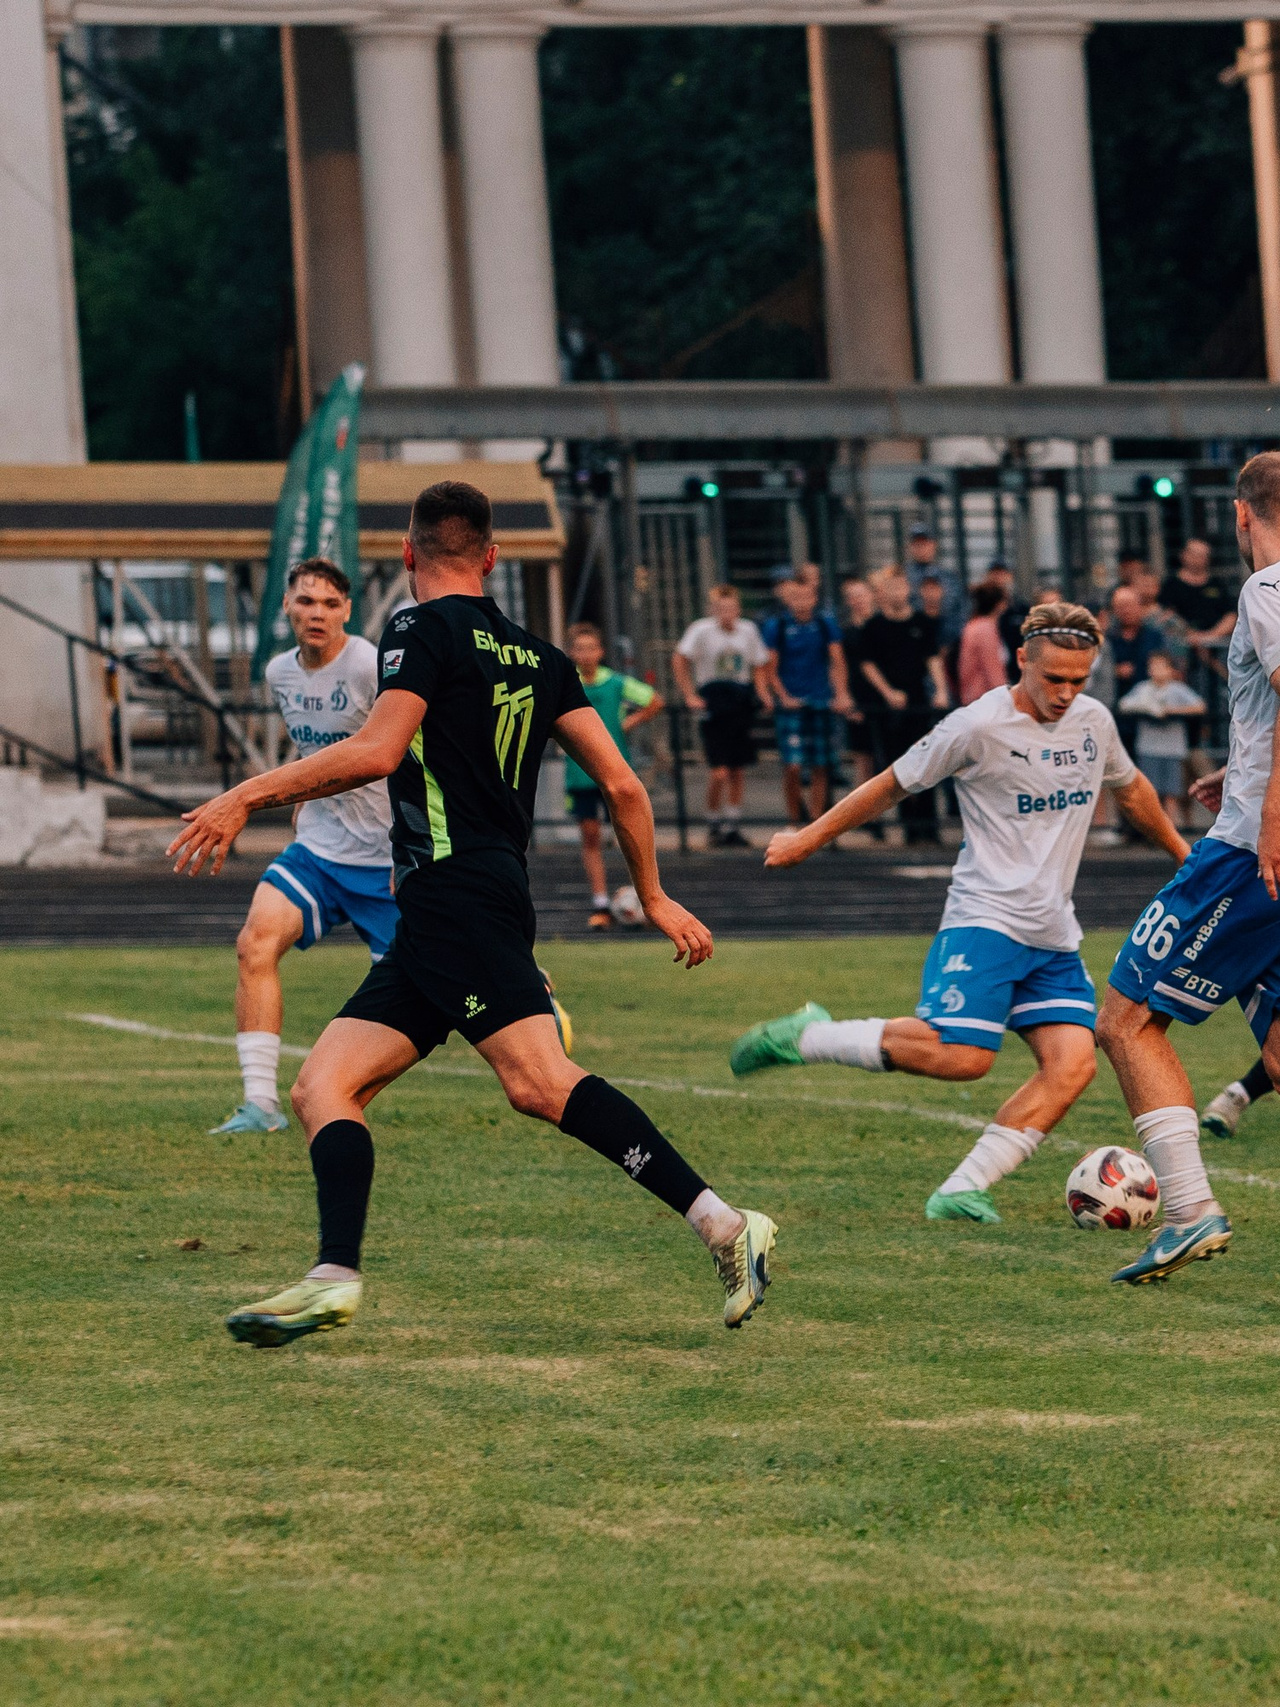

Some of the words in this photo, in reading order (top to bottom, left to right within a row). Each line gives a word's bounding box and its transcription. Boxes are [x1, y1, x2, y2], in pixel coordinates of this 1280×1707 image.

[303, 696, 323, 711] ВТБ
[287, 724, 351, 745] etBoom
[1053, 749, 1078, 767] ВТБ
[1131, 899, 1181, 961] 86
[1182, 896, 1234, 962] BetBoom
[1184, 974, 1223, 999] ВТБ
